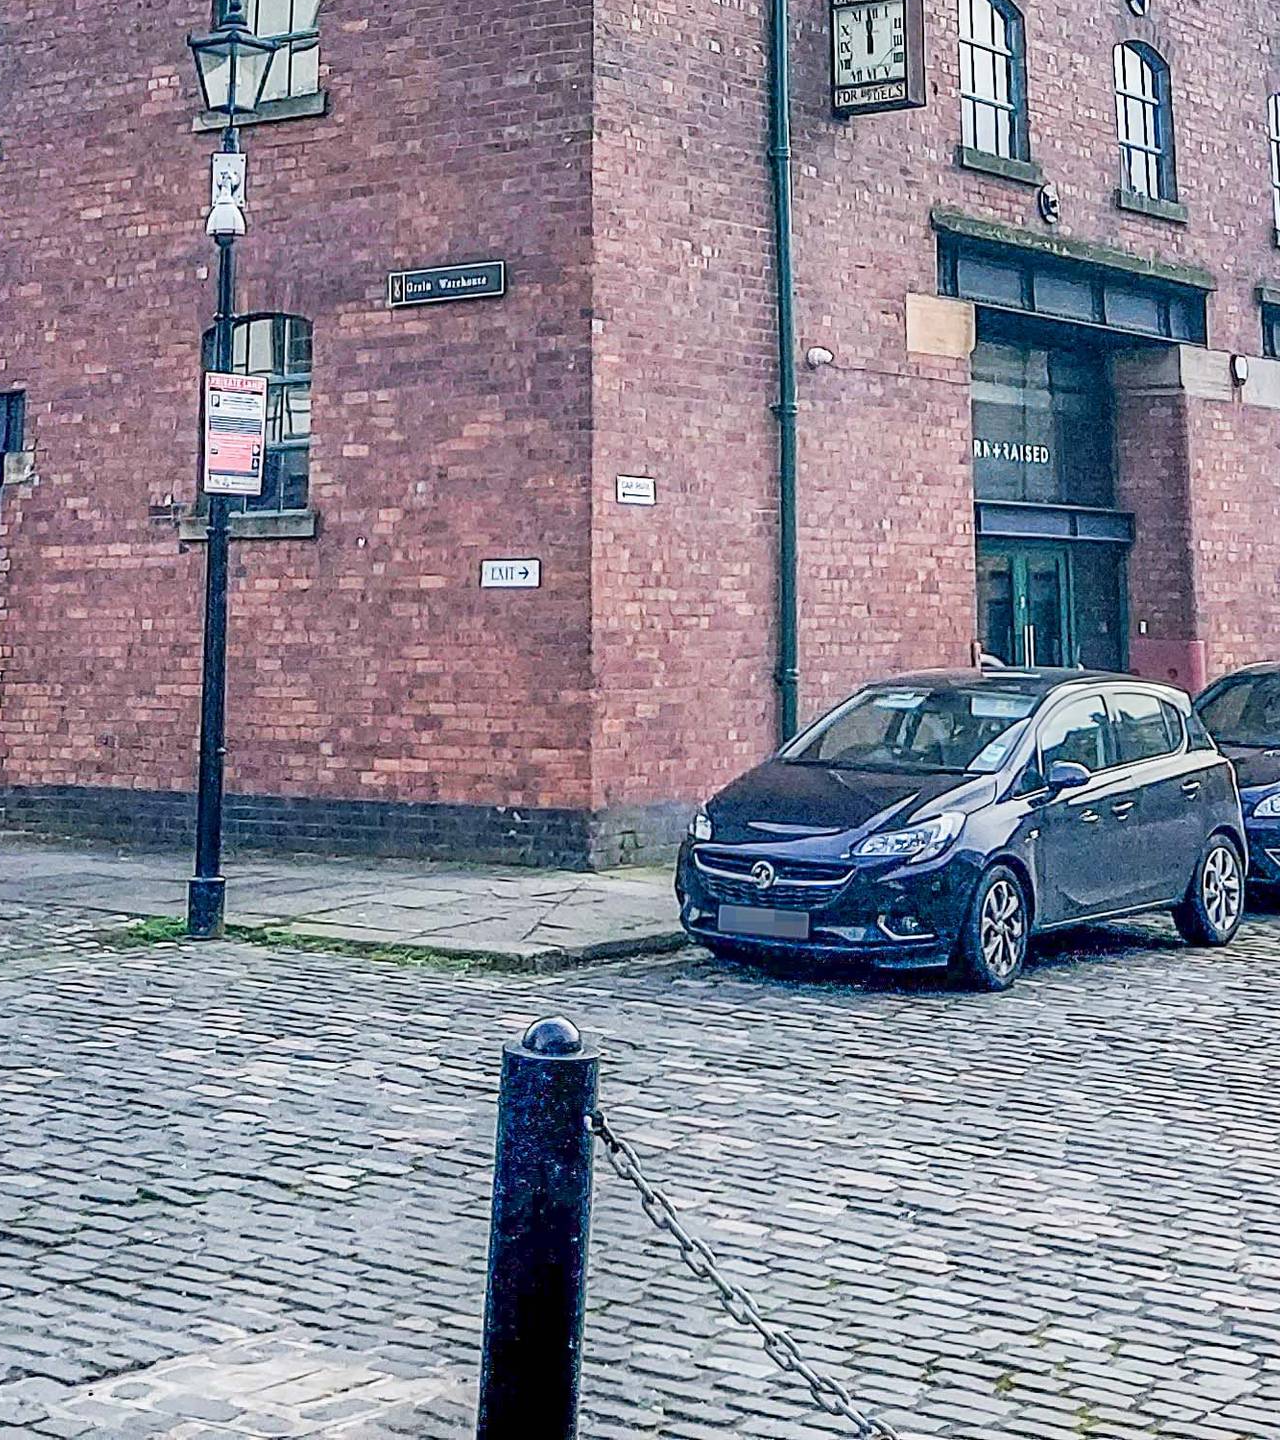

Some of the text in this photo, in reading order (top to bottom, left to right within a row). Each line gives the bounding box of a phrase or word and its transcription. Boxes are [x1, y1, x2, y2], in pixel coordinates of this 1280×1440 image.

[837, 89, 858, 105] FOR
[406, 275, 488, 293] Grain Warehouse
[491, 566, 515, 581] EXIT
